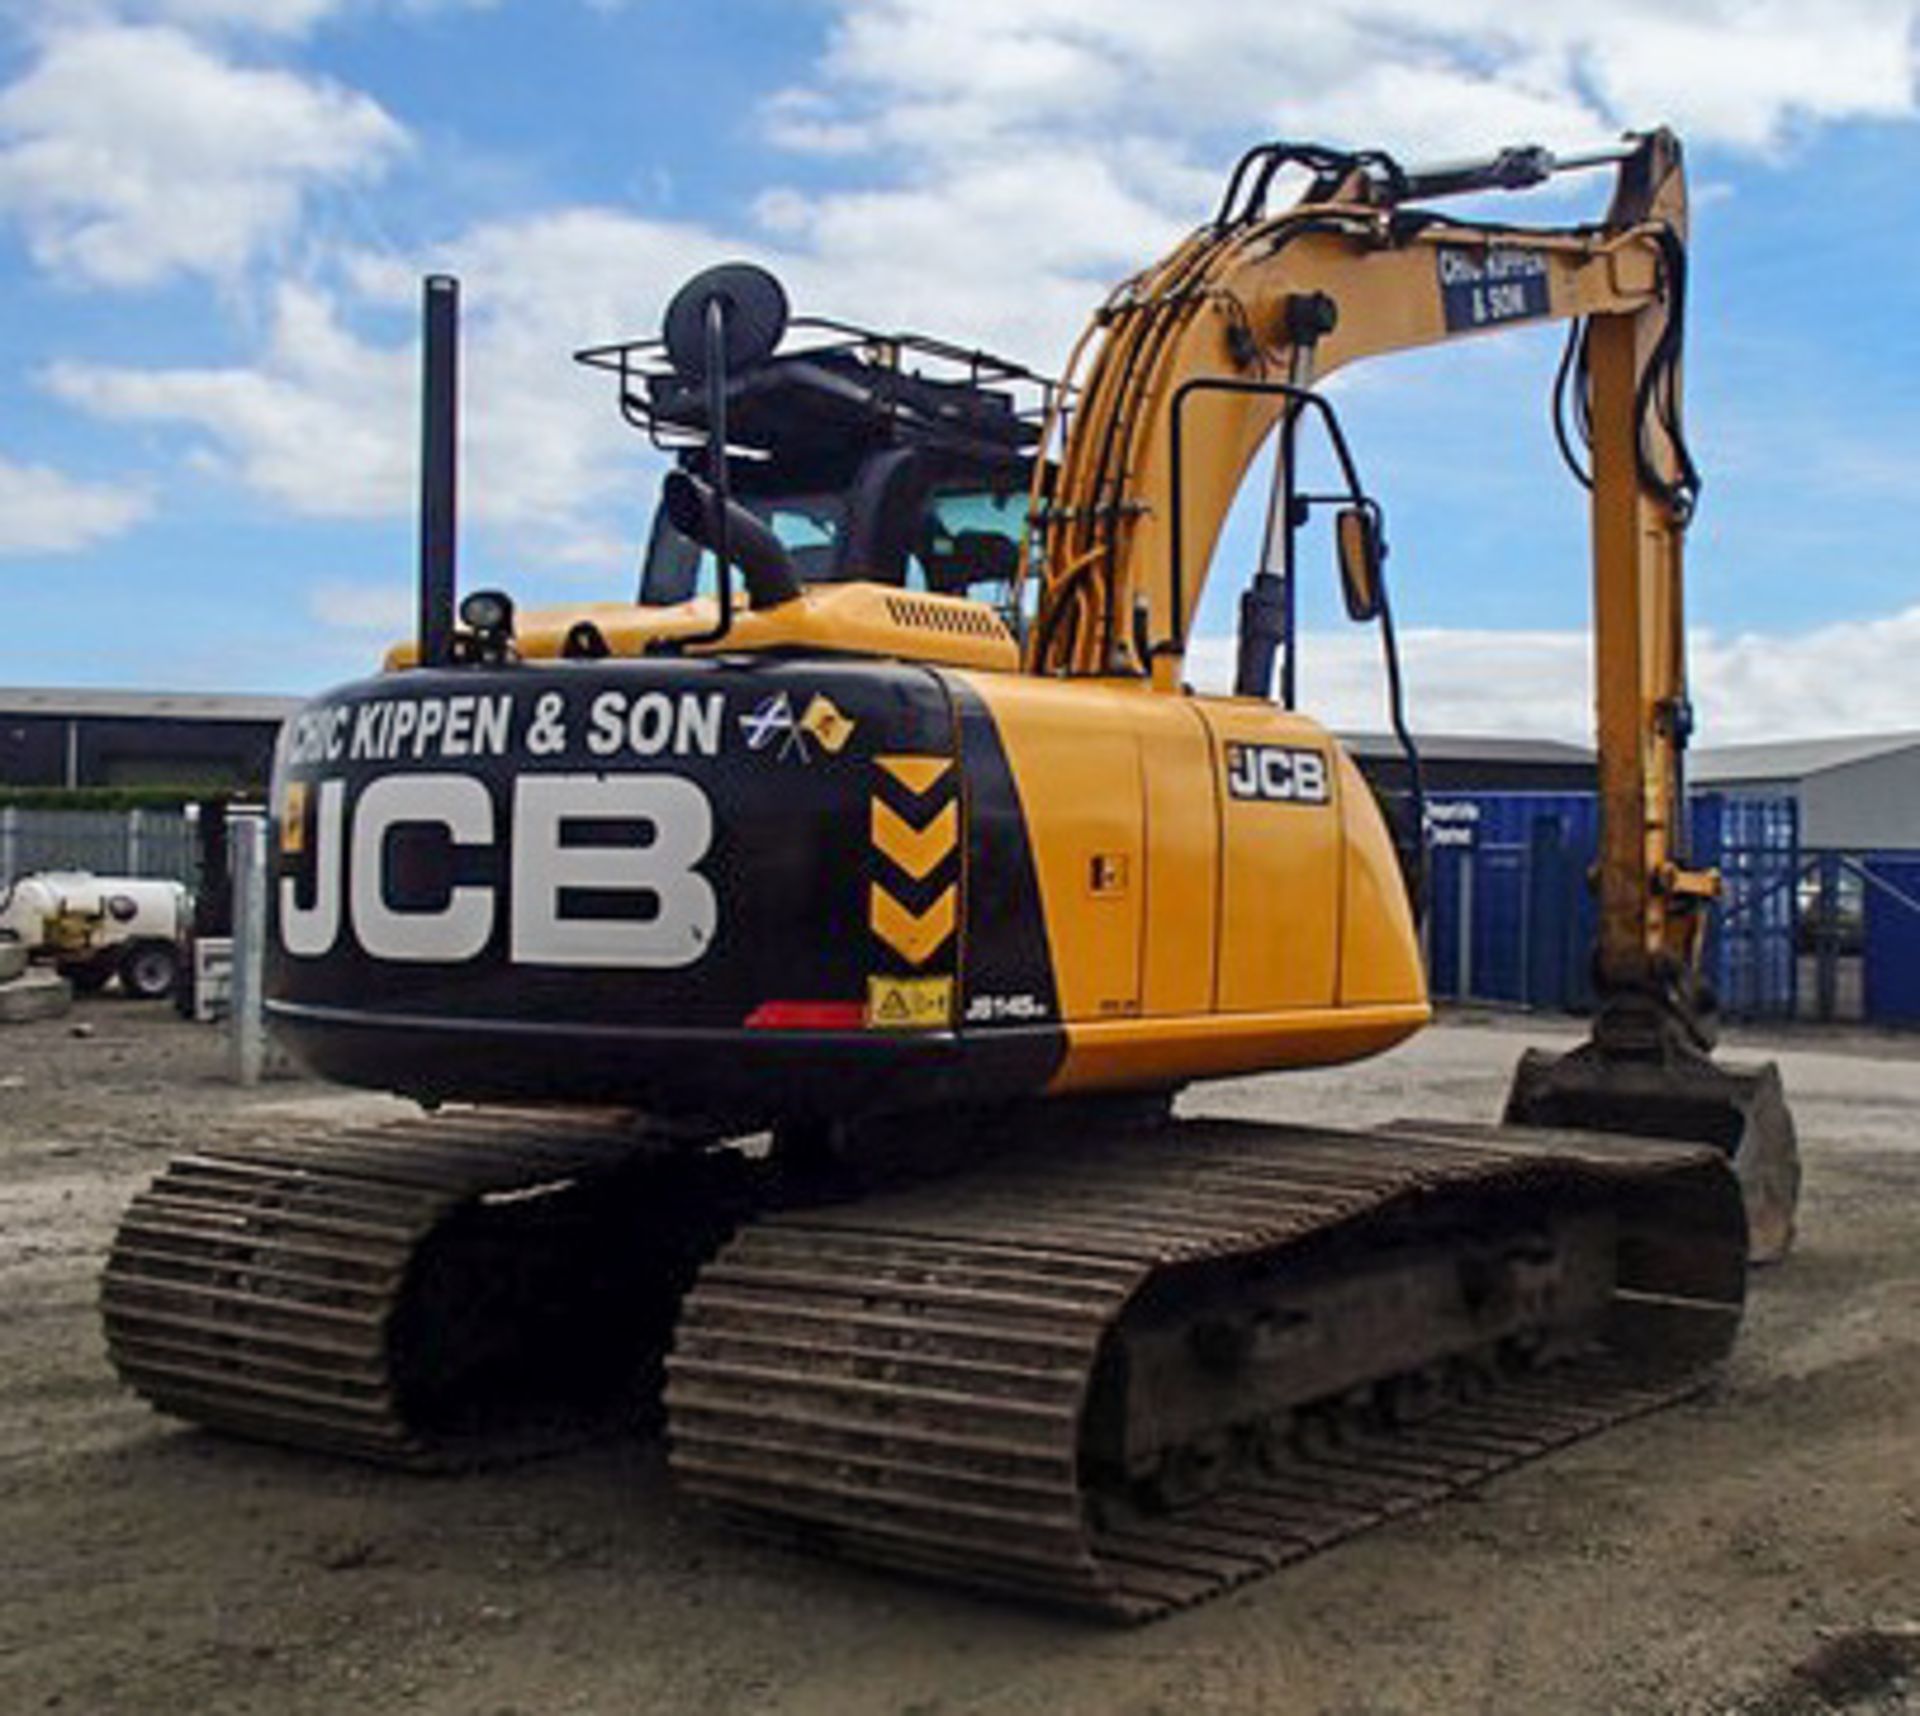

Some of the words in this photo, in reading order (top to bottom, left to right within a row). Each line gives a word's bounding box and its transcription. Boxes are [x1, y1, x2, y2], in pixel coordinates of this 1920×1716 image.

[350, 695, 512, 760] KIPPEN
[526, 691, 567, 755] &
[587, 691, 726, 756] SON
[1230, 747, 1325, 801] JCB
[278, 771, 718, 970] JCB
